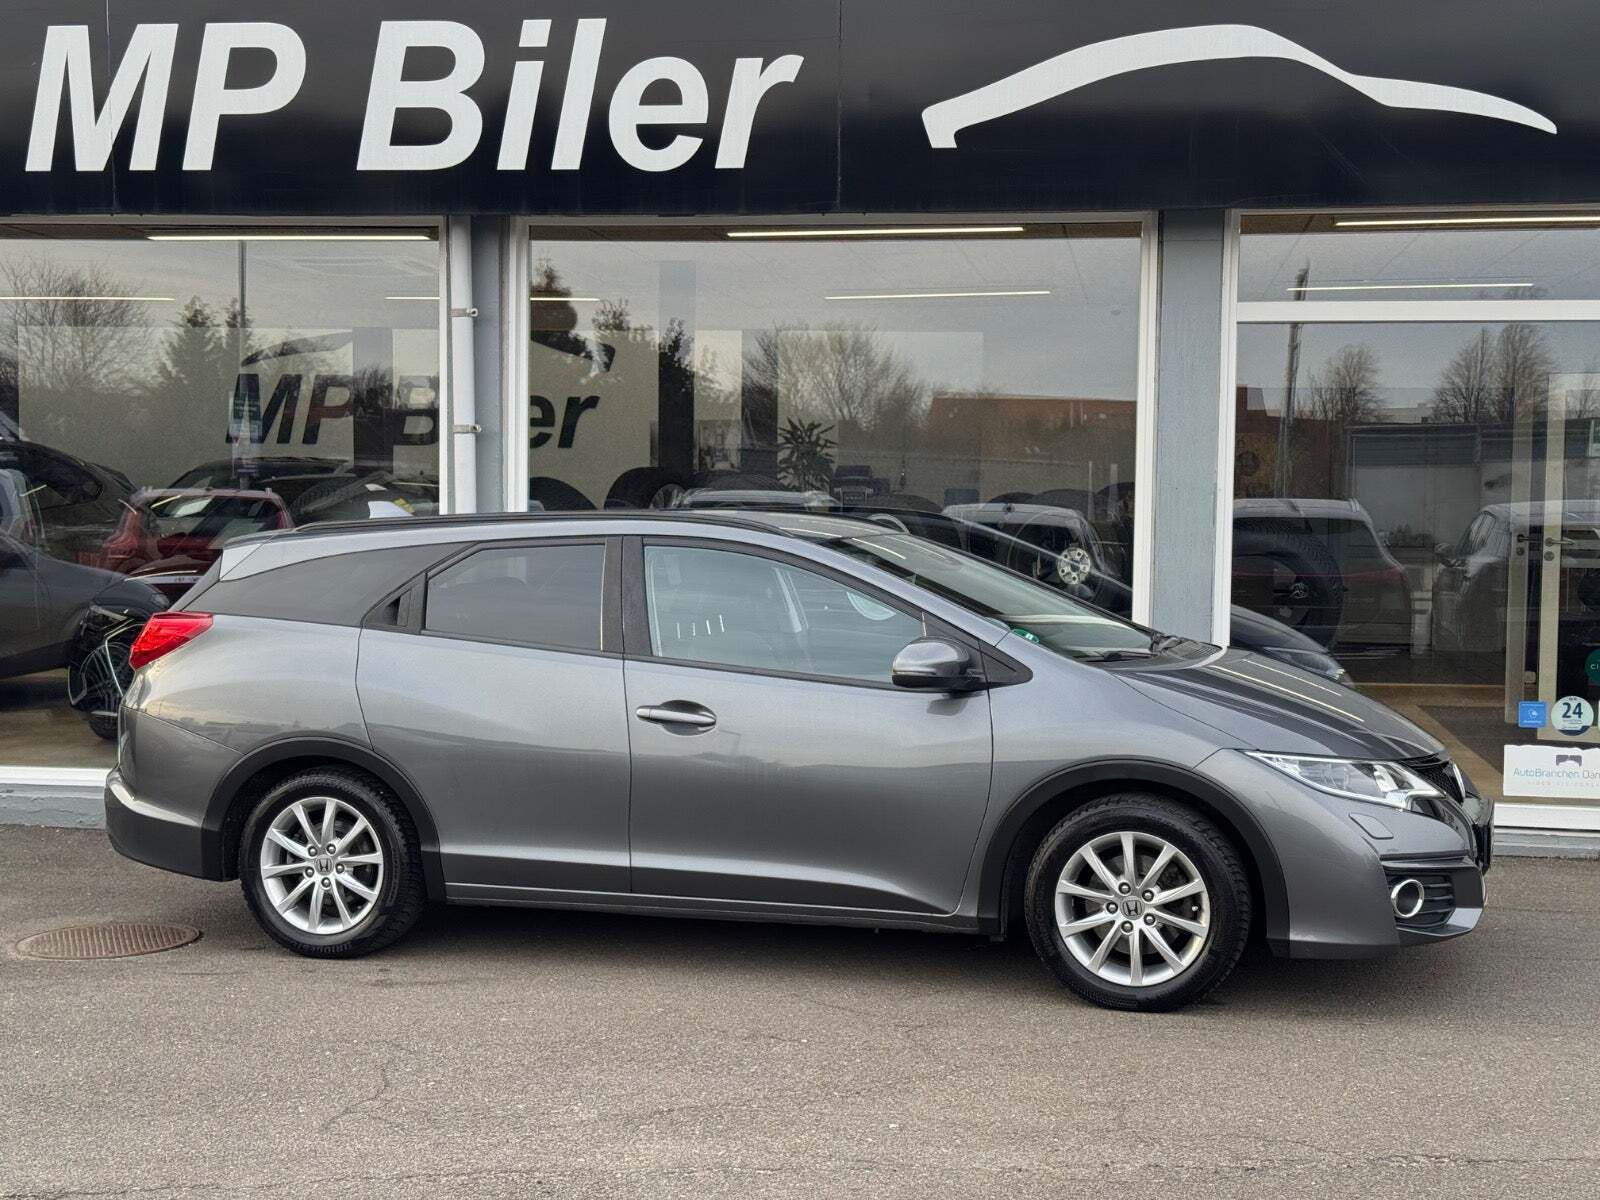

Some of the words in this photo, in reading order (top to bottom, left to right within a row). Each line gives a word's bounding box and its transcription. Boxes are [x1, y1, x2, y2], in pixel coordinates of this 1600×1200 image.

[25, 22, 306, 171] MP
[356, 18, 804, 171] Biler
[226, 373, 354, 445] MP
[1562, 702, 1583, 719] 24
[1512, 767, 1580, 779] AutoBranchen
